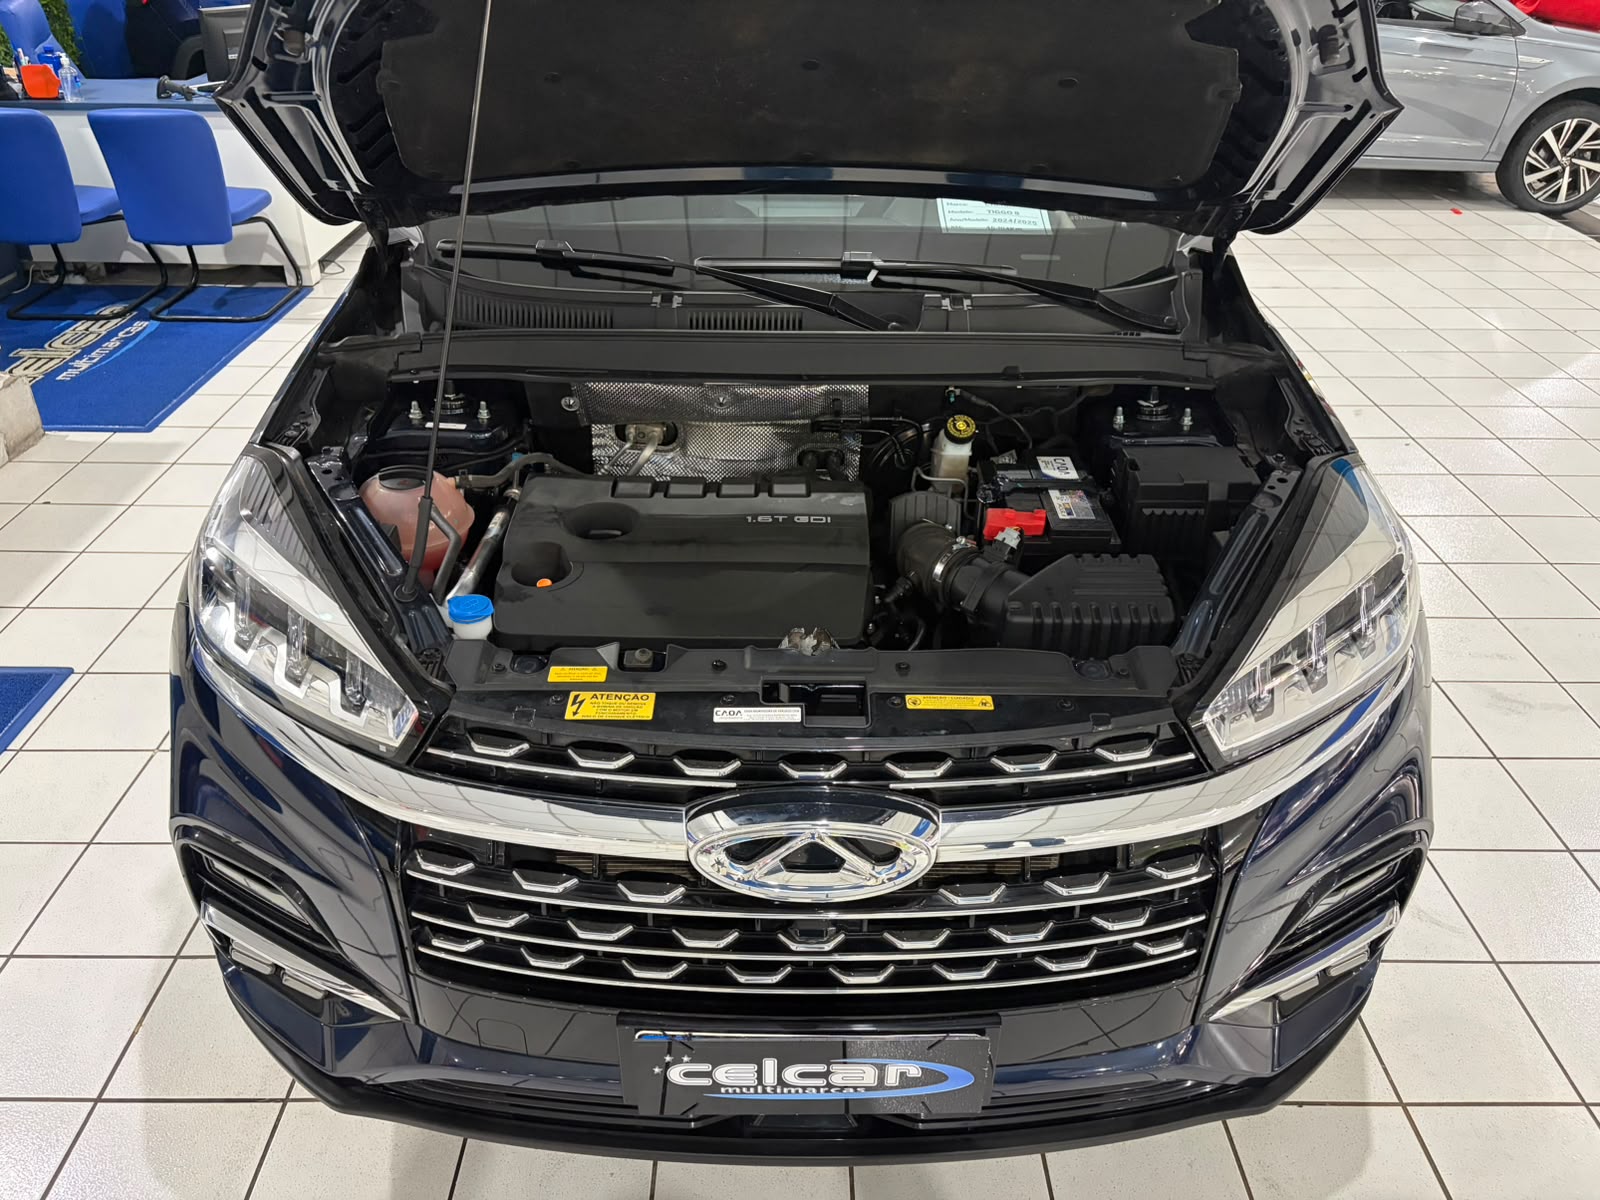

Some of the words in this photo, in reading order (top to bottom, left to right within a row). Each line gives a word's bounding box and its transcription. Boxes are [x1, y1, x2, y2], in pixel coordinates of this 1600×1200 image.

[992, 217, 1038, 226] 2024/2025
[55, 320, 150, 381] multimarcas
[746, 515, 788, 523] 1.6T
[794, 515, 831, 523] GDI
[590, 693, 650, 701] ATENÇÃO
[666, 1058, 922, 1087] celcar
[720, 1085, 866, 1095] multimarcas
